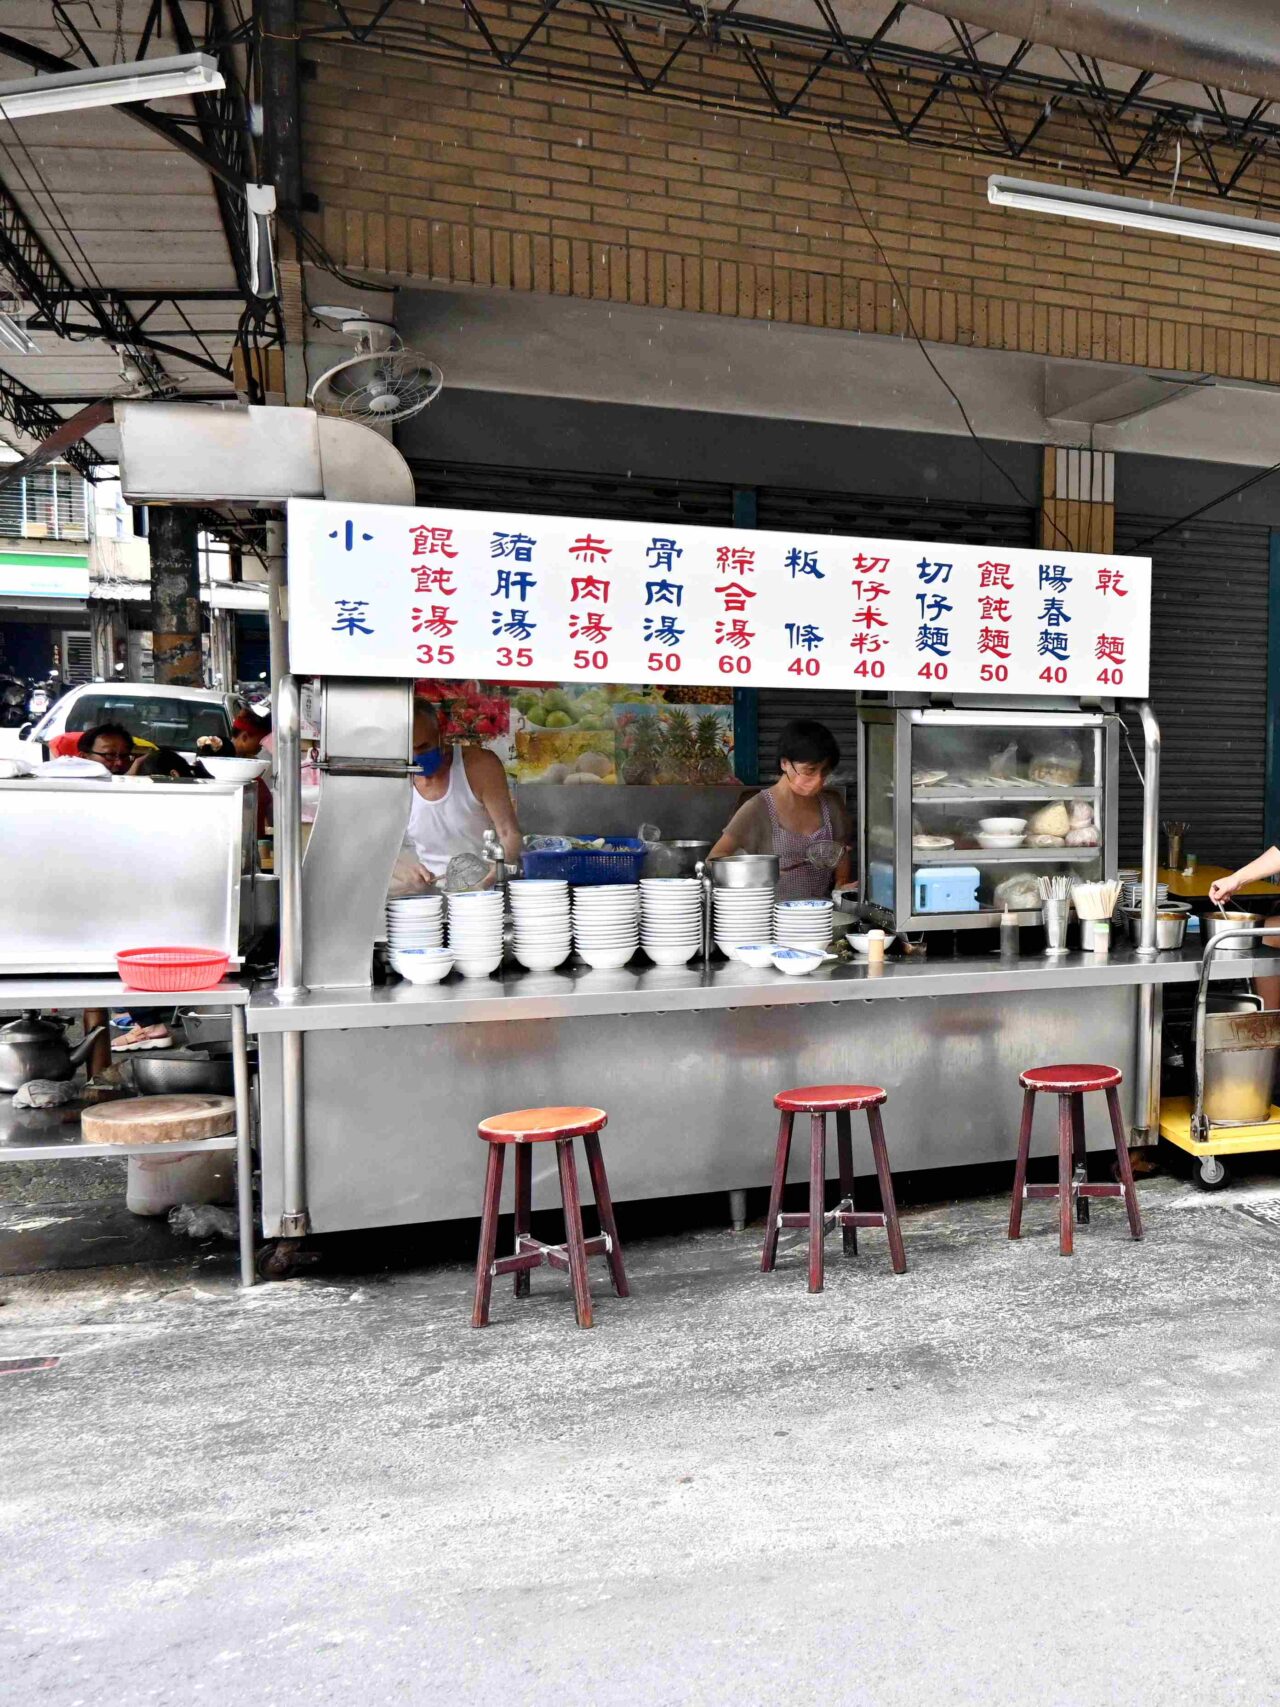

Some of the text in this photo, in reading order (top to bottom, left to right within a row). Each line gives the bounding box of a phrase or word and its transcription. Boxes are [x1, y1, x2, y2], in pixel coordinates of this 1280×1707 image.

[329, 519, 373, 635] 小菜
[409, 525, 458, 665] 餛飩湯 35
[490, 532, 537, 667] 豬肝湯 35
[569, 534, 613, 670] 赤肉湯 50
[643, 538, 684, 672] 骨肉湯 50
[714, 546, 757, 675] 綜合湯 60
[784, 548, 825, 677] 粄條 40
[849, 552, 891, 678] 切仔米粉 40
[916, 557, 953, 680] 切仔麵 40
[978, 561, 1014, 683] 餛飩麵 50
[1037, 564, 1072, 684] 陽春麵 40
[1095, 569, 1128, 685] 乾麵 40
